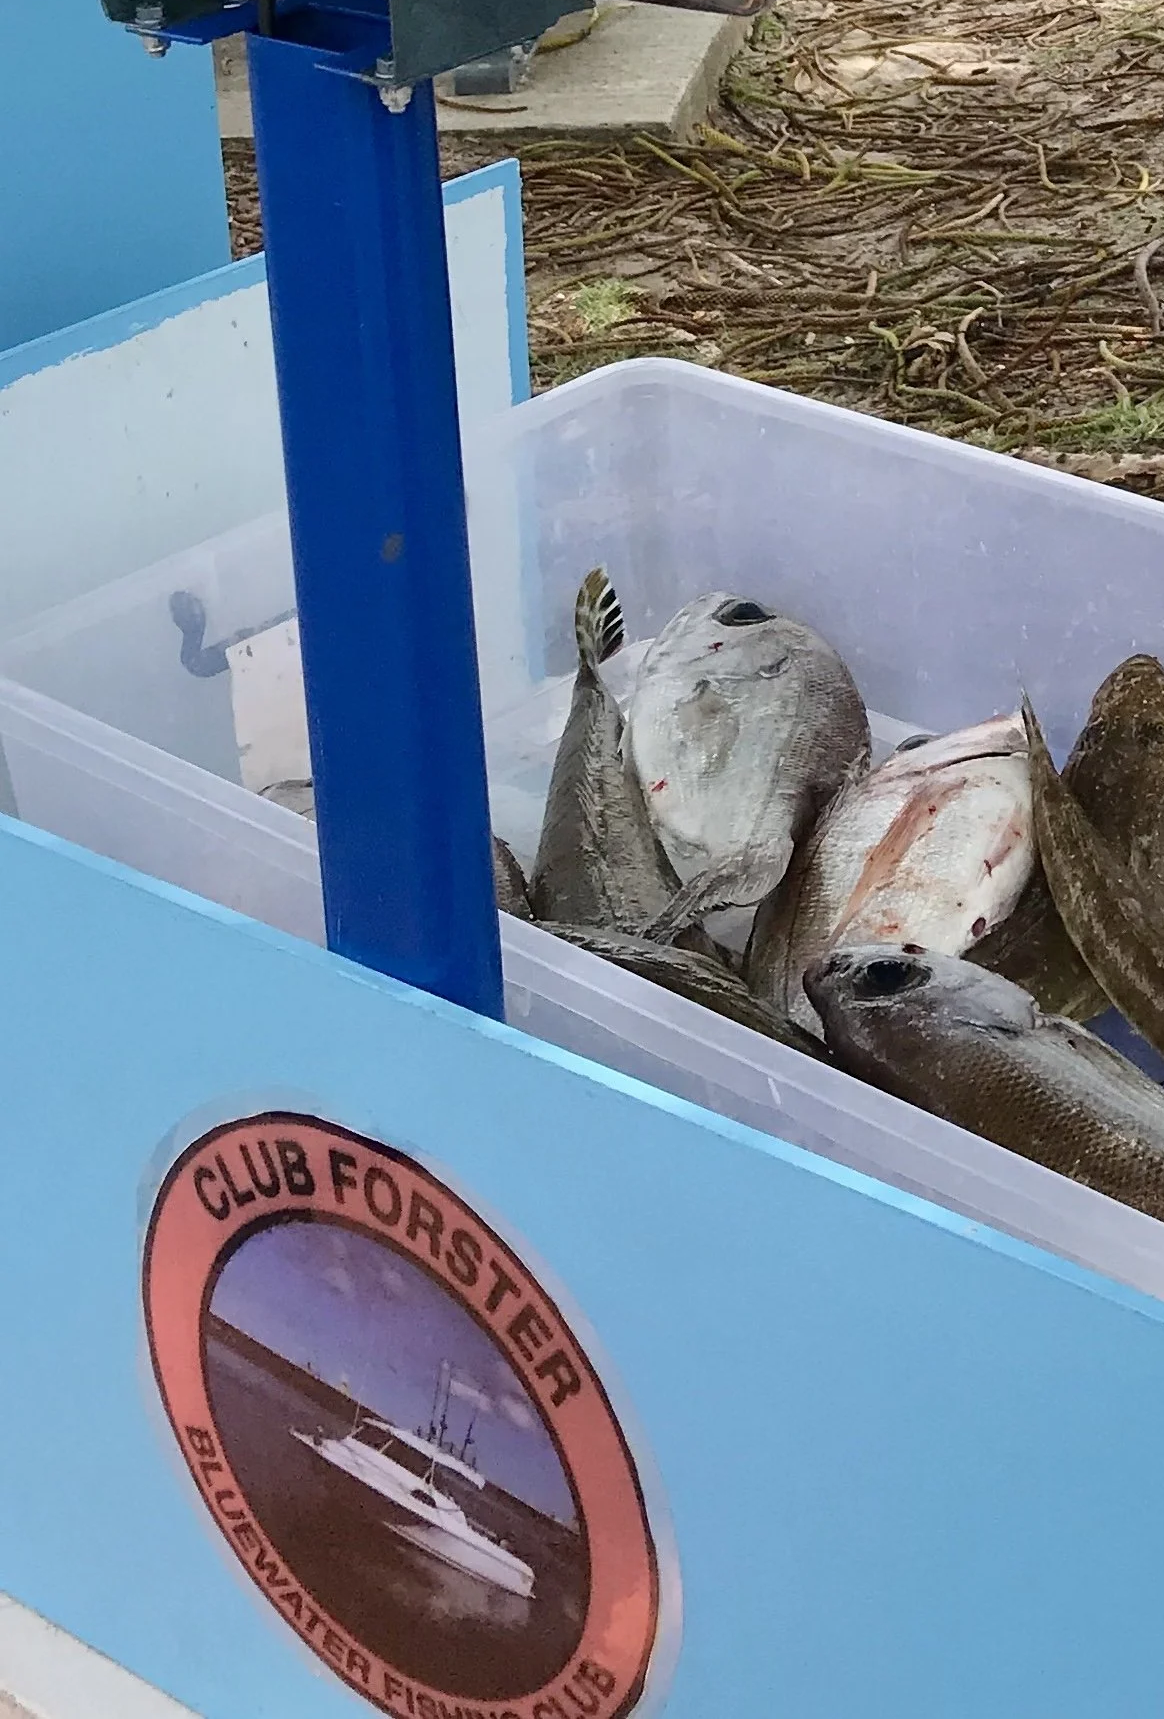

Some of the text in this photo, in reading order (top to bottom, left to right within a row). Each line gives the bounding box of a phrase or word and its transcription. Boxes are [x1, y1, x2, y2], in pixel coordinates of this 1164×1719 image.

[194, 1136, 581, 1409] CLUB FORSTER
[184, 1424, 617, 1719] BLUEWATER FISH CLUB
